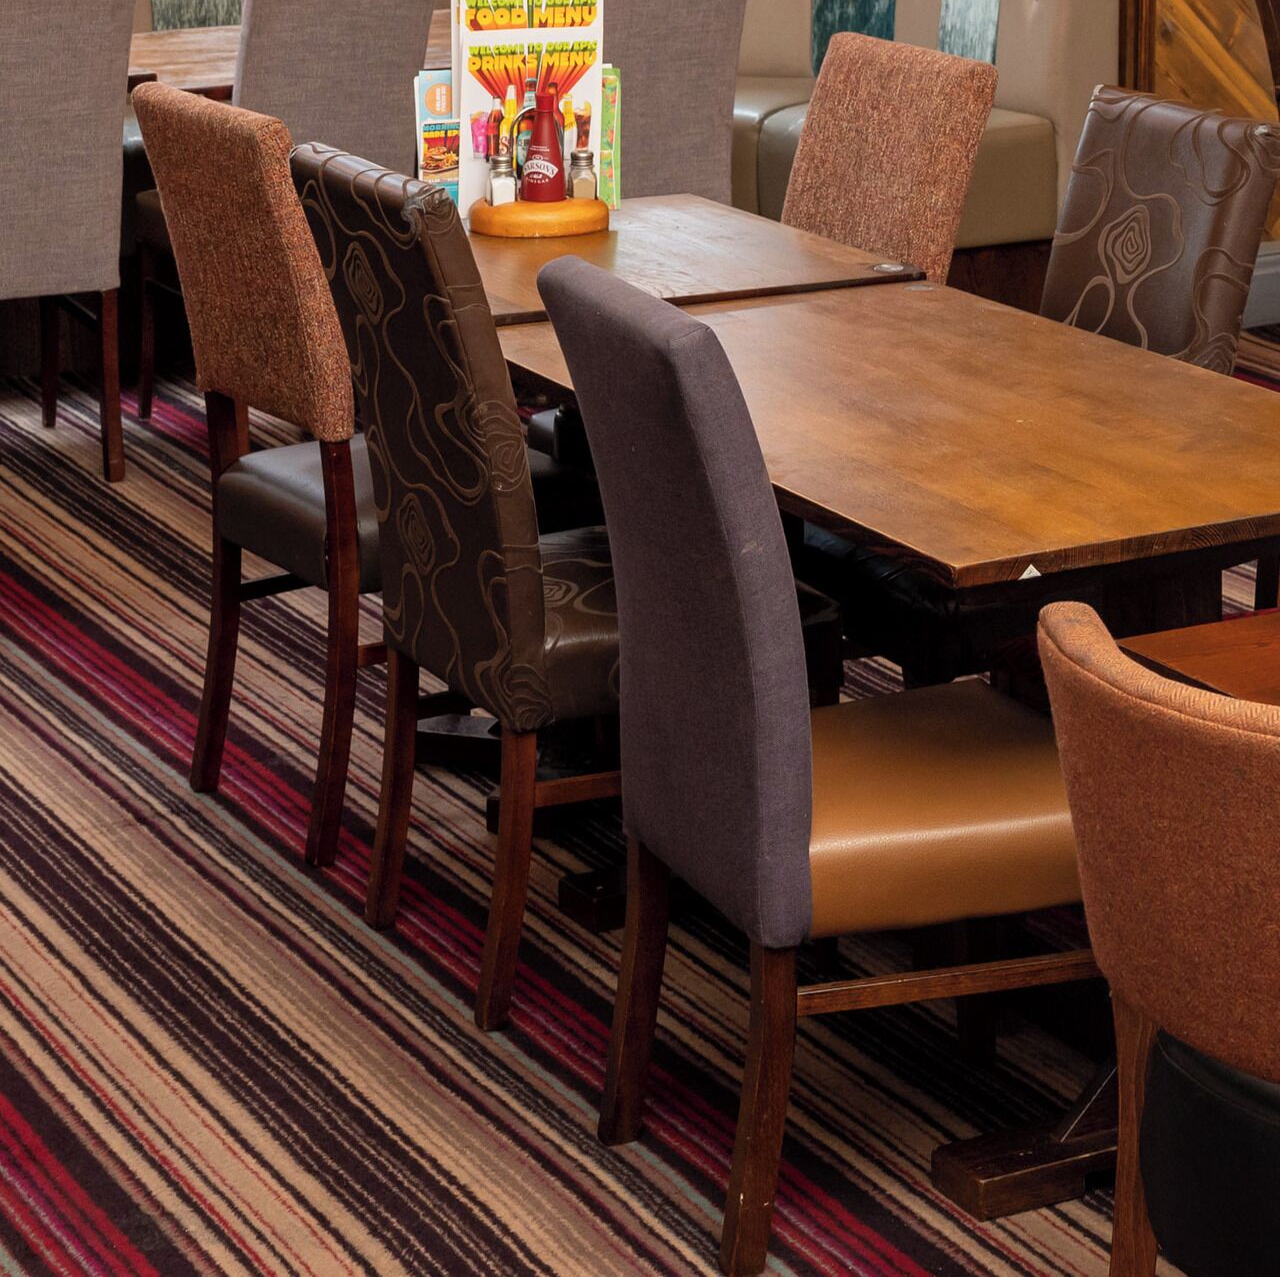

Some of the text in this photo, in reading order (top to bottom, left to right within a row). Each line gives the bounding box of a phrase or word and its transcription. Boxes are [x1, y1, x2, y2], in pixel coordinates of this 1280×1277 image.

[465, 6, 597, 27] FOOD MENU
[469, 41, 597, 56] WELCOME TO OUR EPIC
[468, 51, 596, 71] DRINKS MENU
